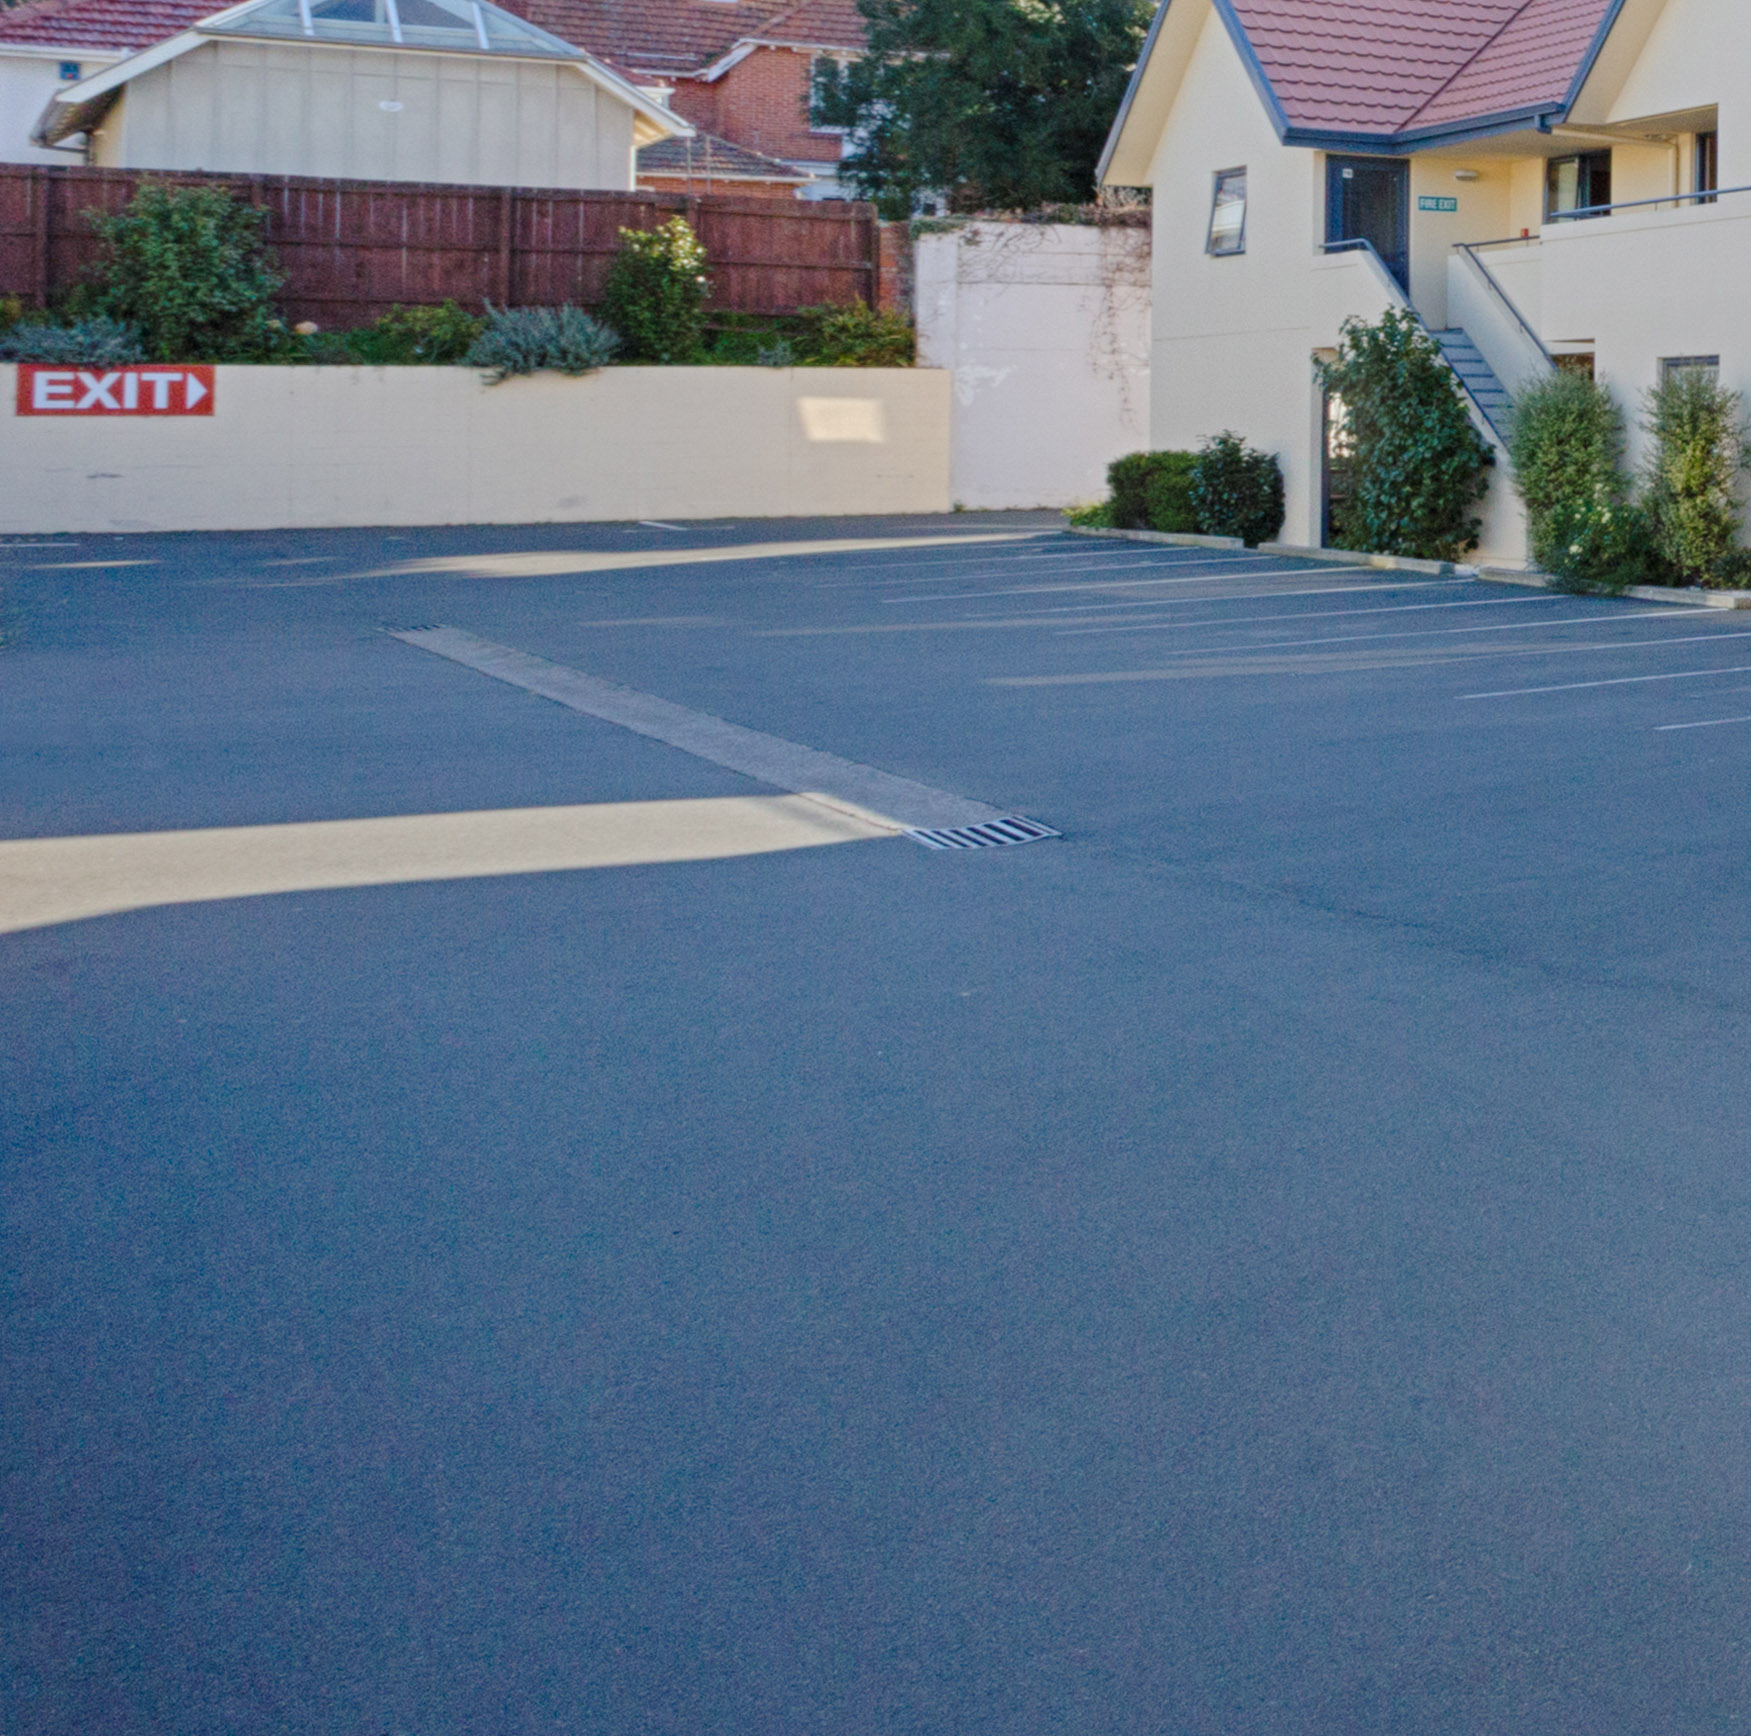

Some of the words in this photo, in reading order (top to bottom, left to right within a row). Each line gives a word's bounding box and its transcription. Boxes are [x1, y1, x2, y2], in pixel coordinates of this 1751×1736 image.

[1420, 198, 1437, 210] FIRE
[1439, 199, 1456, 211] EXIT
[33, 371, 184, 409] EXIT
